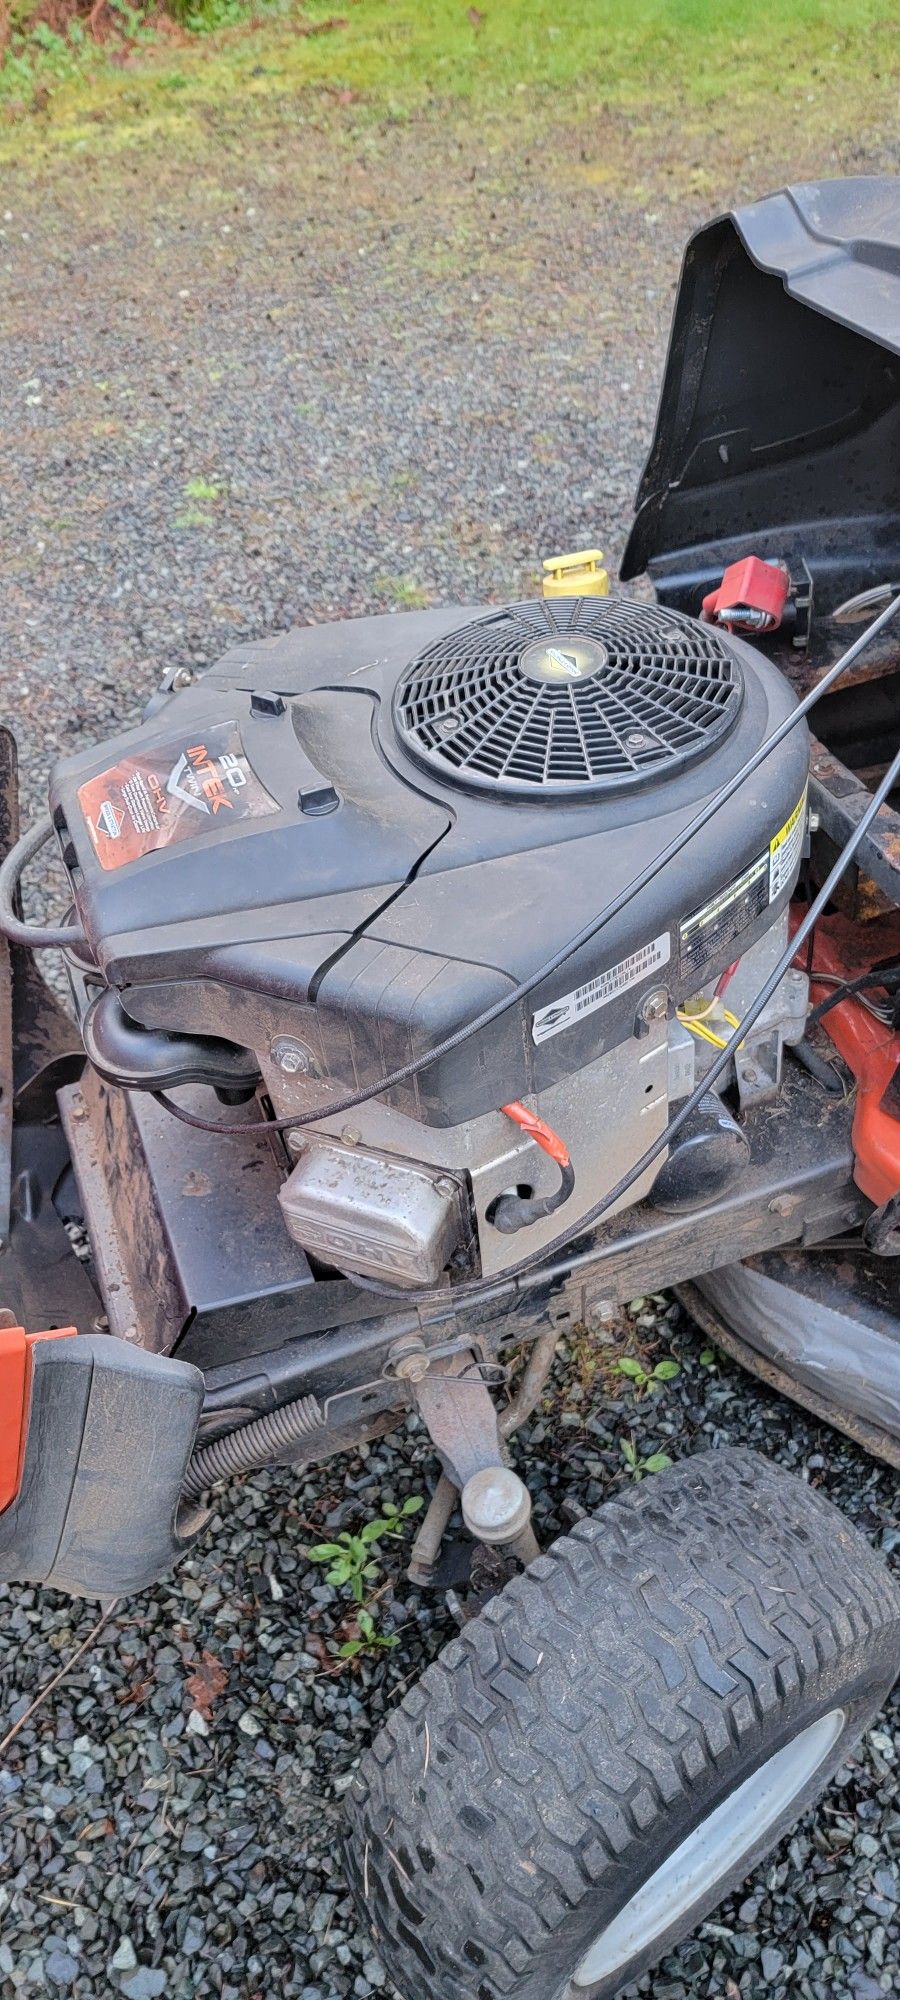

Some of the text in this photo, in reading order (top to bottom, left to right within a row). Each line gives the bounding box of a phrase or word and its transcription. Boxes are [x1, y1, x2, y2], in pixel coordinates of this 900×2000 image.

[184, 765, 202, 797] TWIN
[186, 745, 234, 815] INTEK
[218, 753, 247, 788] 20
[147, 774, 170, 814] OHV
